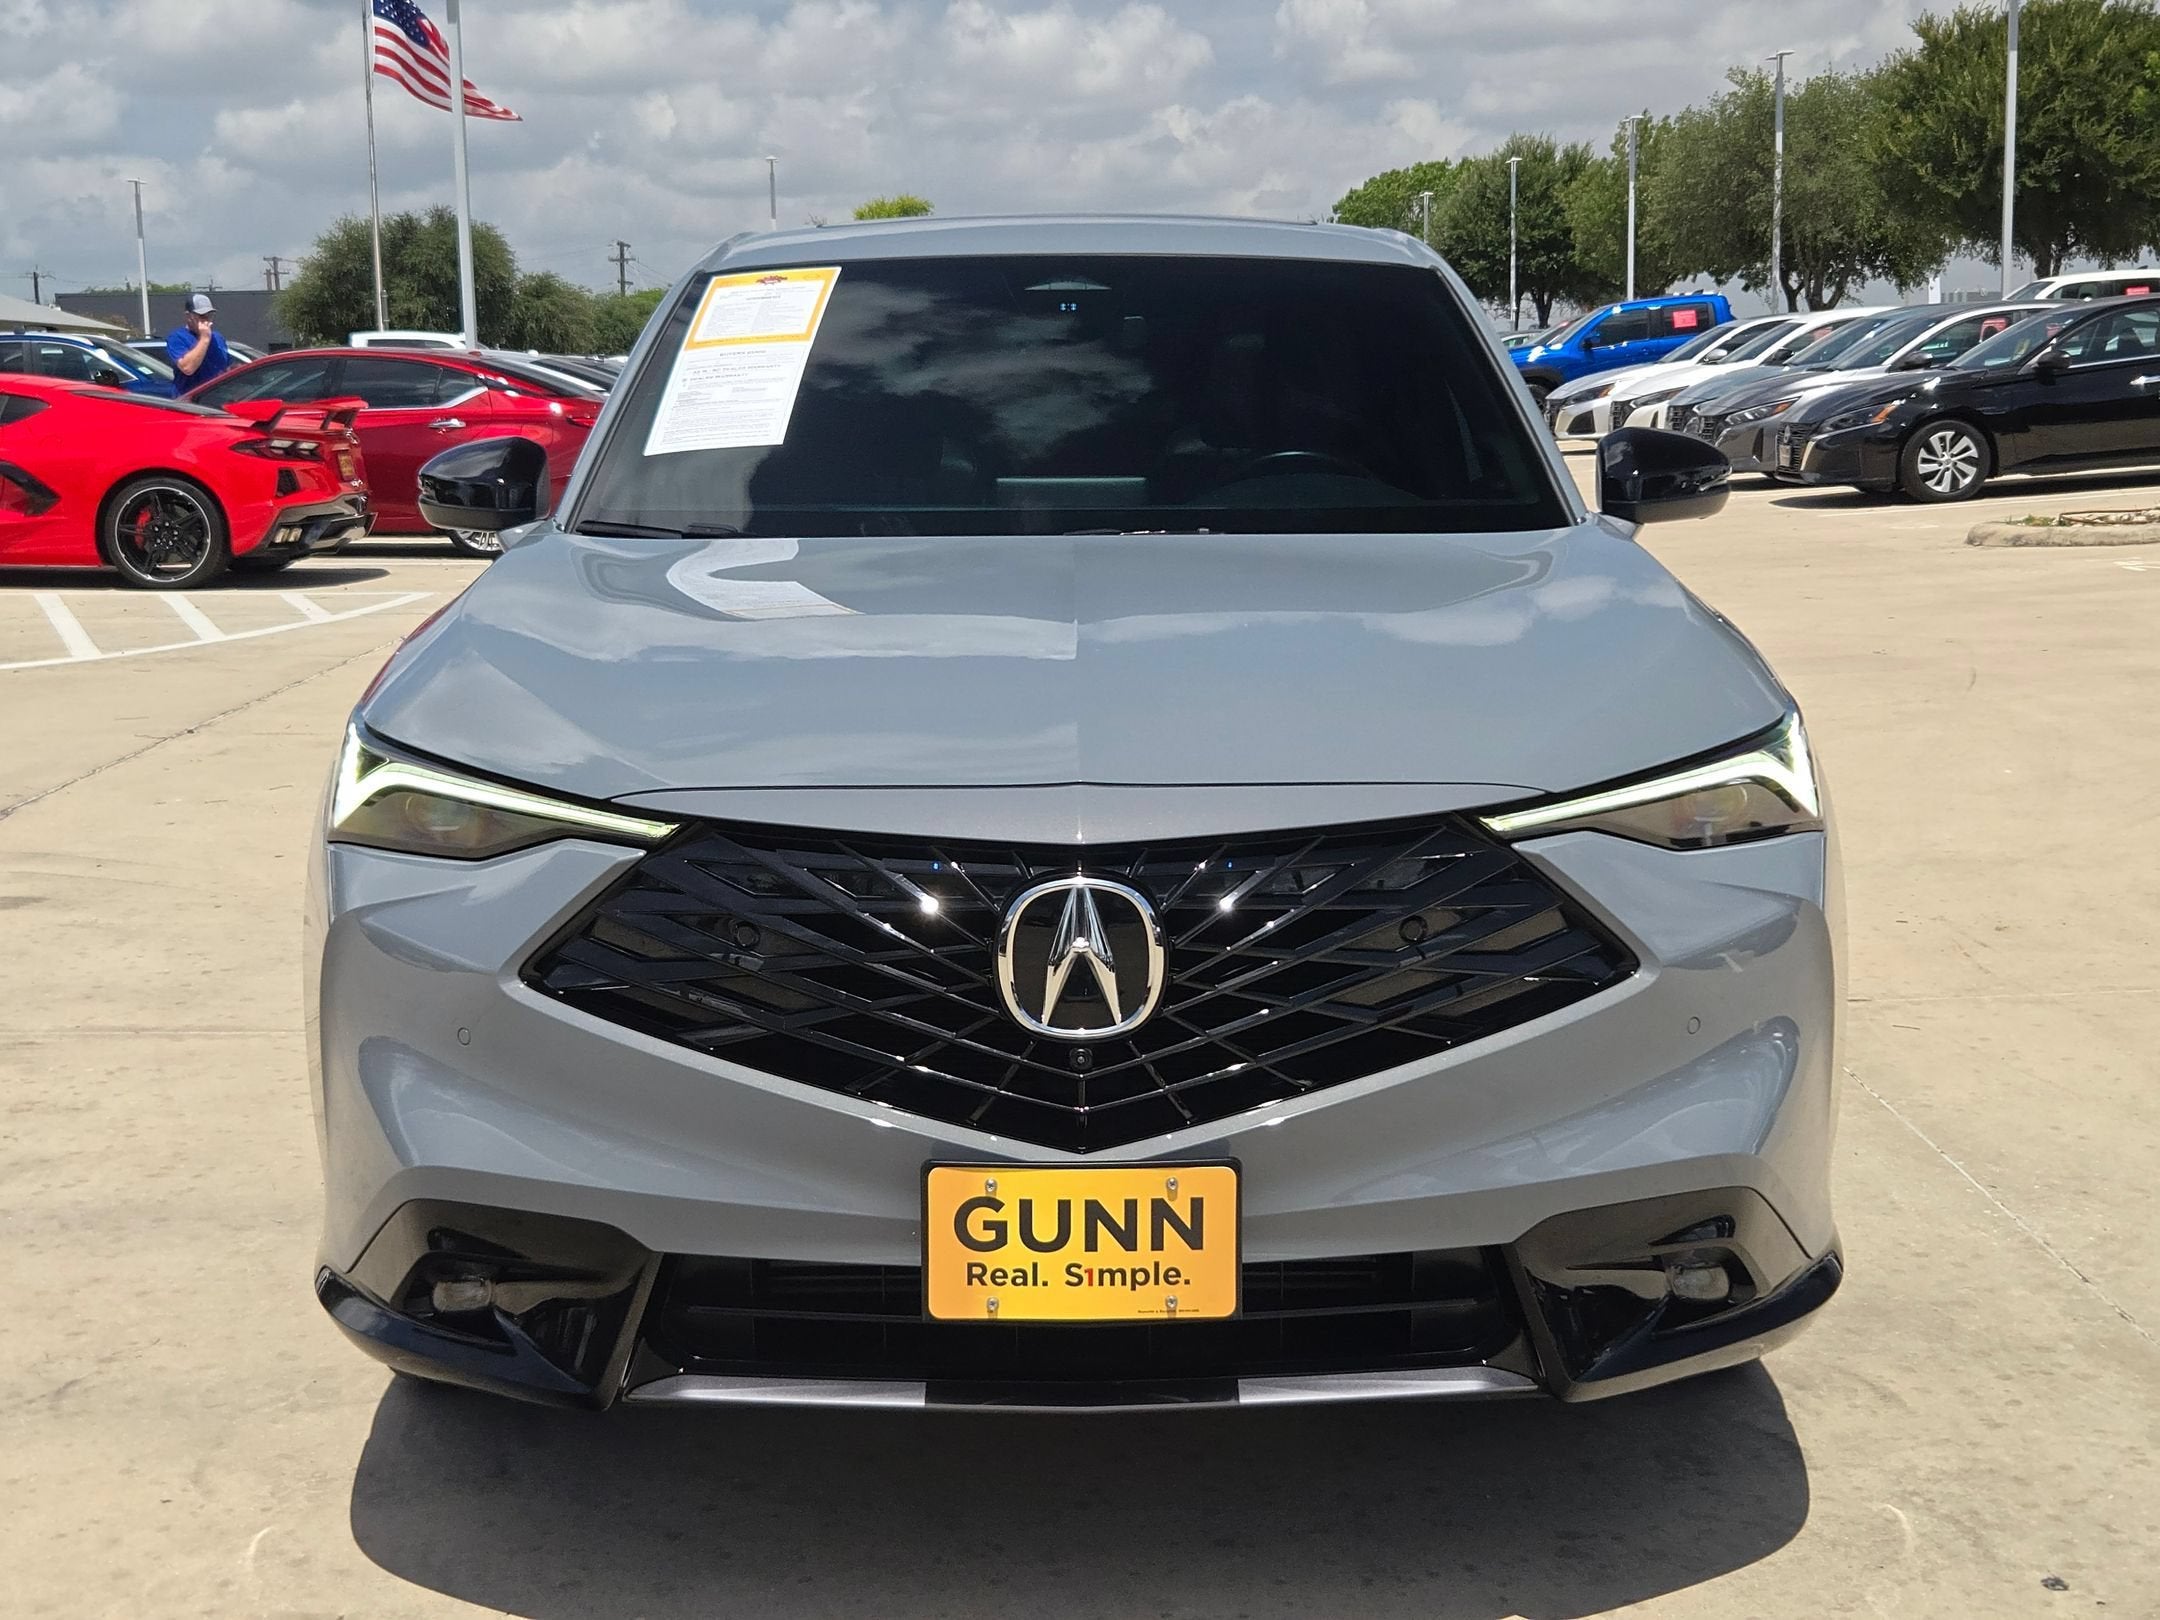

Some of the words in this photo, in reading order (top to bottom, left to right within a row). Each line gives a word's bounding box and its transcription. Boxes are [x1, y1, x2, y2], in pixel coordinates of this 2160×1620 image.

[953, 1195, 1204, 1253] GUNN
[966, 1261, 1048, 1287] Real.
[1064, 1261, 1191, 1291] S1mple.
